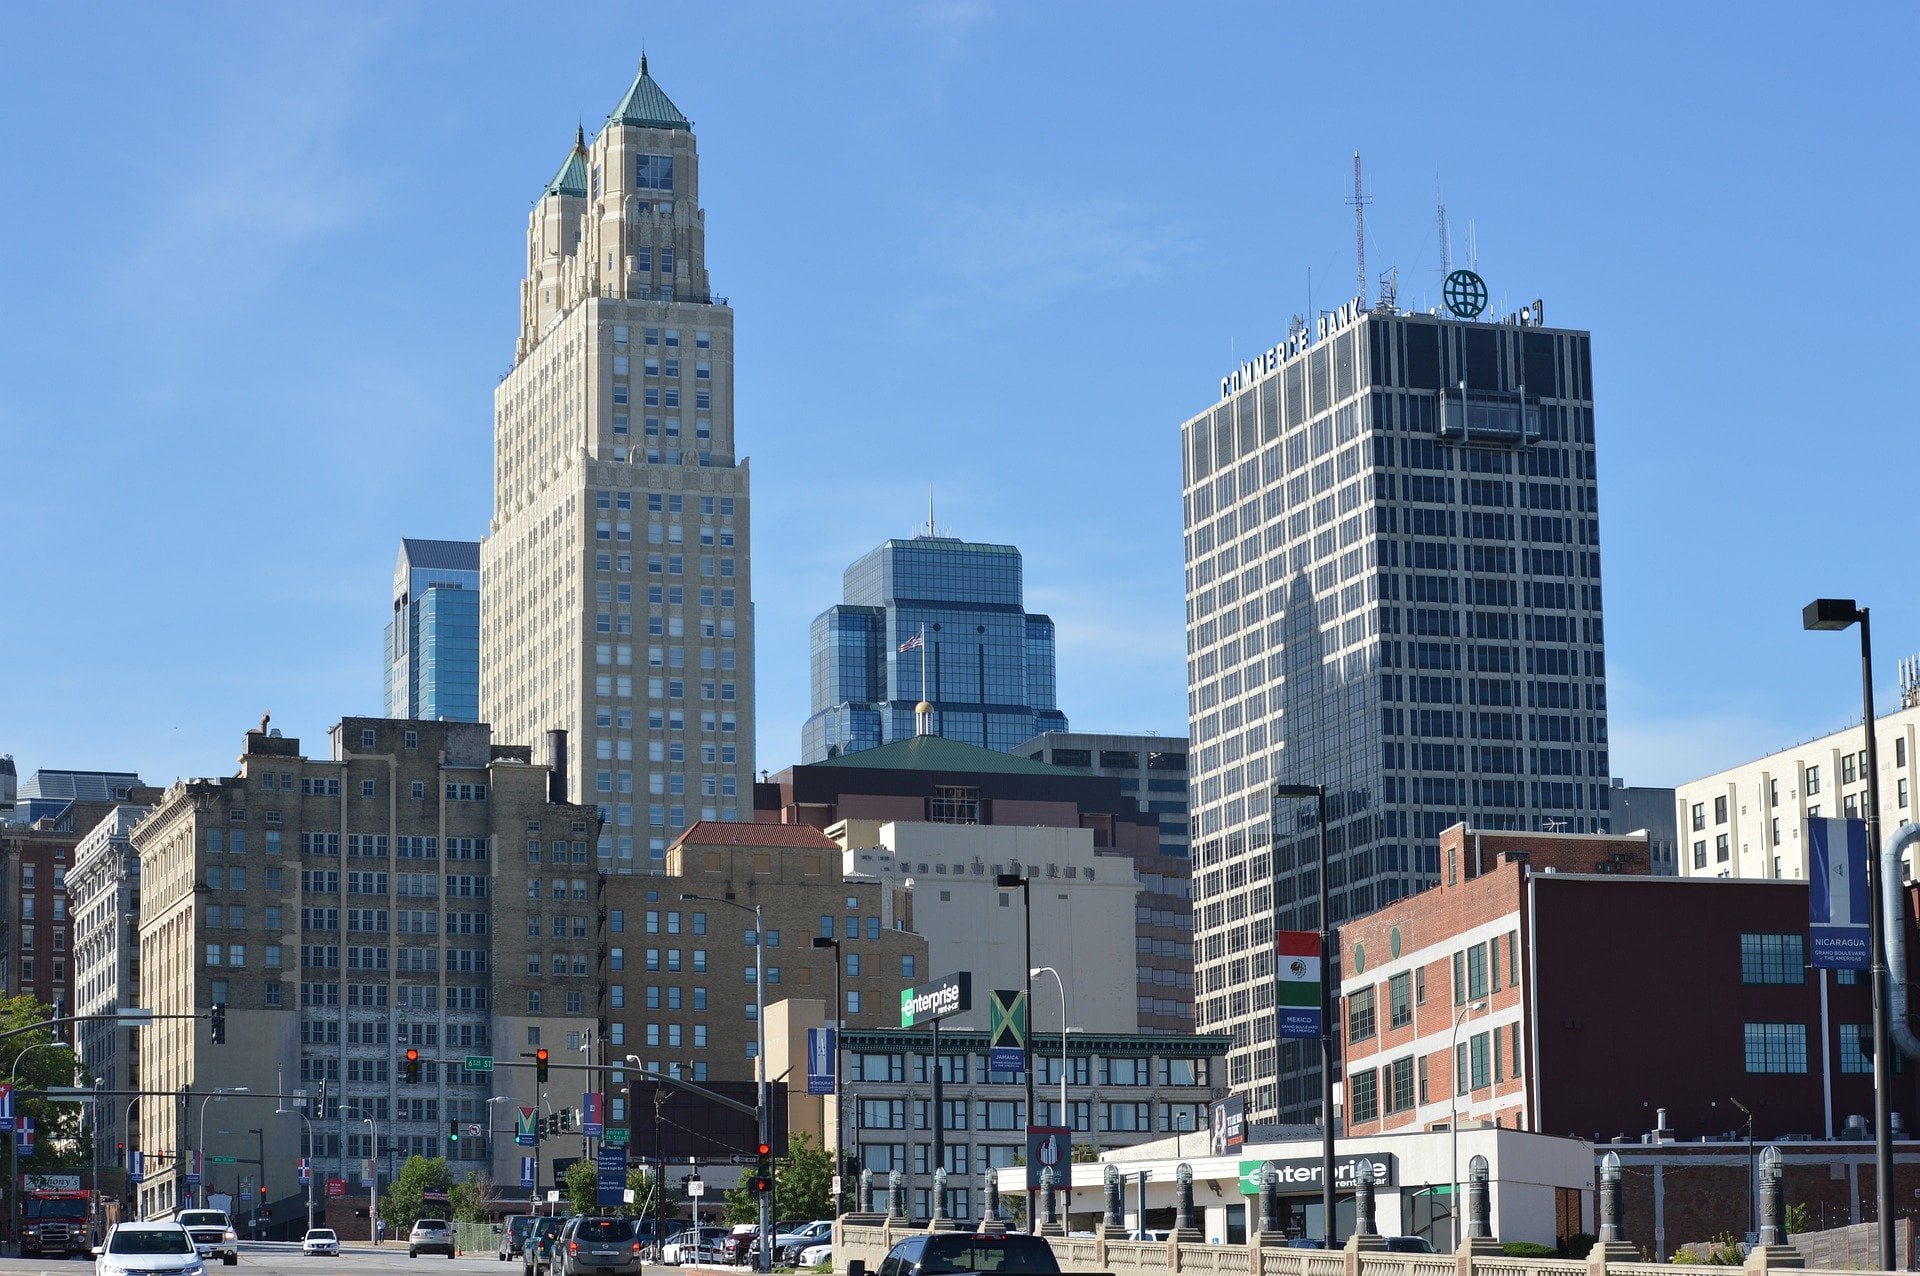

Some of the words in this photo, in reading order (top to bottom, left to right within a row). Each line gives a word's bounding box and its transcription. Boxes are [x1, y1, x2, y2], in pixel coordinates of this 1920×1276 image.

[1220, 327, 1308, 401] COMMERCE
[1317, 296, 1360, 341] BANK
[1815, 938, 1865, 947] NICARAGUA
[903, 983, 959, 1017] enterprise
[938, 1002, 959, 1014] rent-a-car
[484, 1060, 492, 1068] ST
